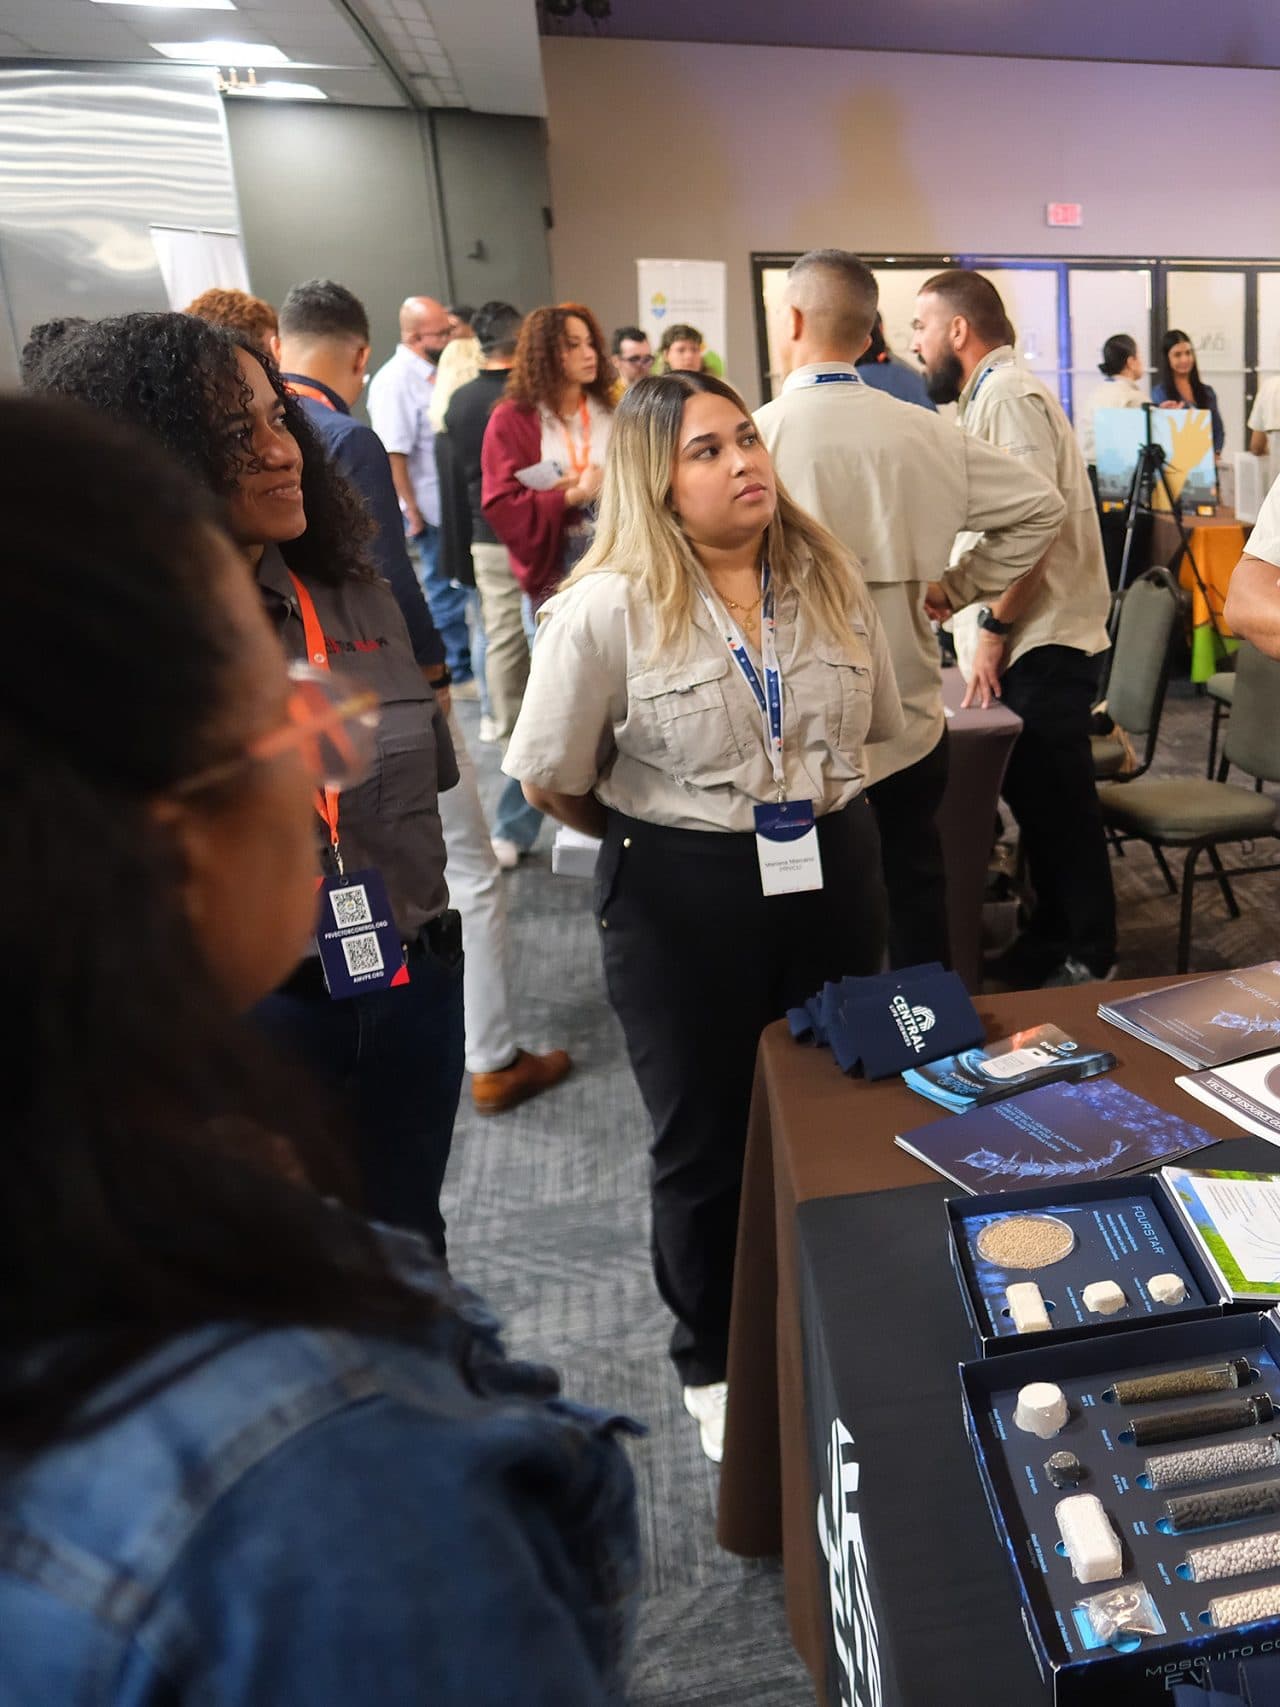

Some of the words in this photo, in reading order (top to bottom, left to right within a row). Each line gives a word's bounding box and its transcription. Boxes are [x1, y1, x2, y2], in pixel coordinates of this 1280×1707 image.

[888, 1003, 899, 1018] LIFE
[892, 995, 926, 1054] CENTRAL
[1206, 1079, 1236, 1100] VECTOR
[1232, 1098, 1273, 1122] RESOURCE
[1131, 1205, 1166, 1255] FOURSTAR
